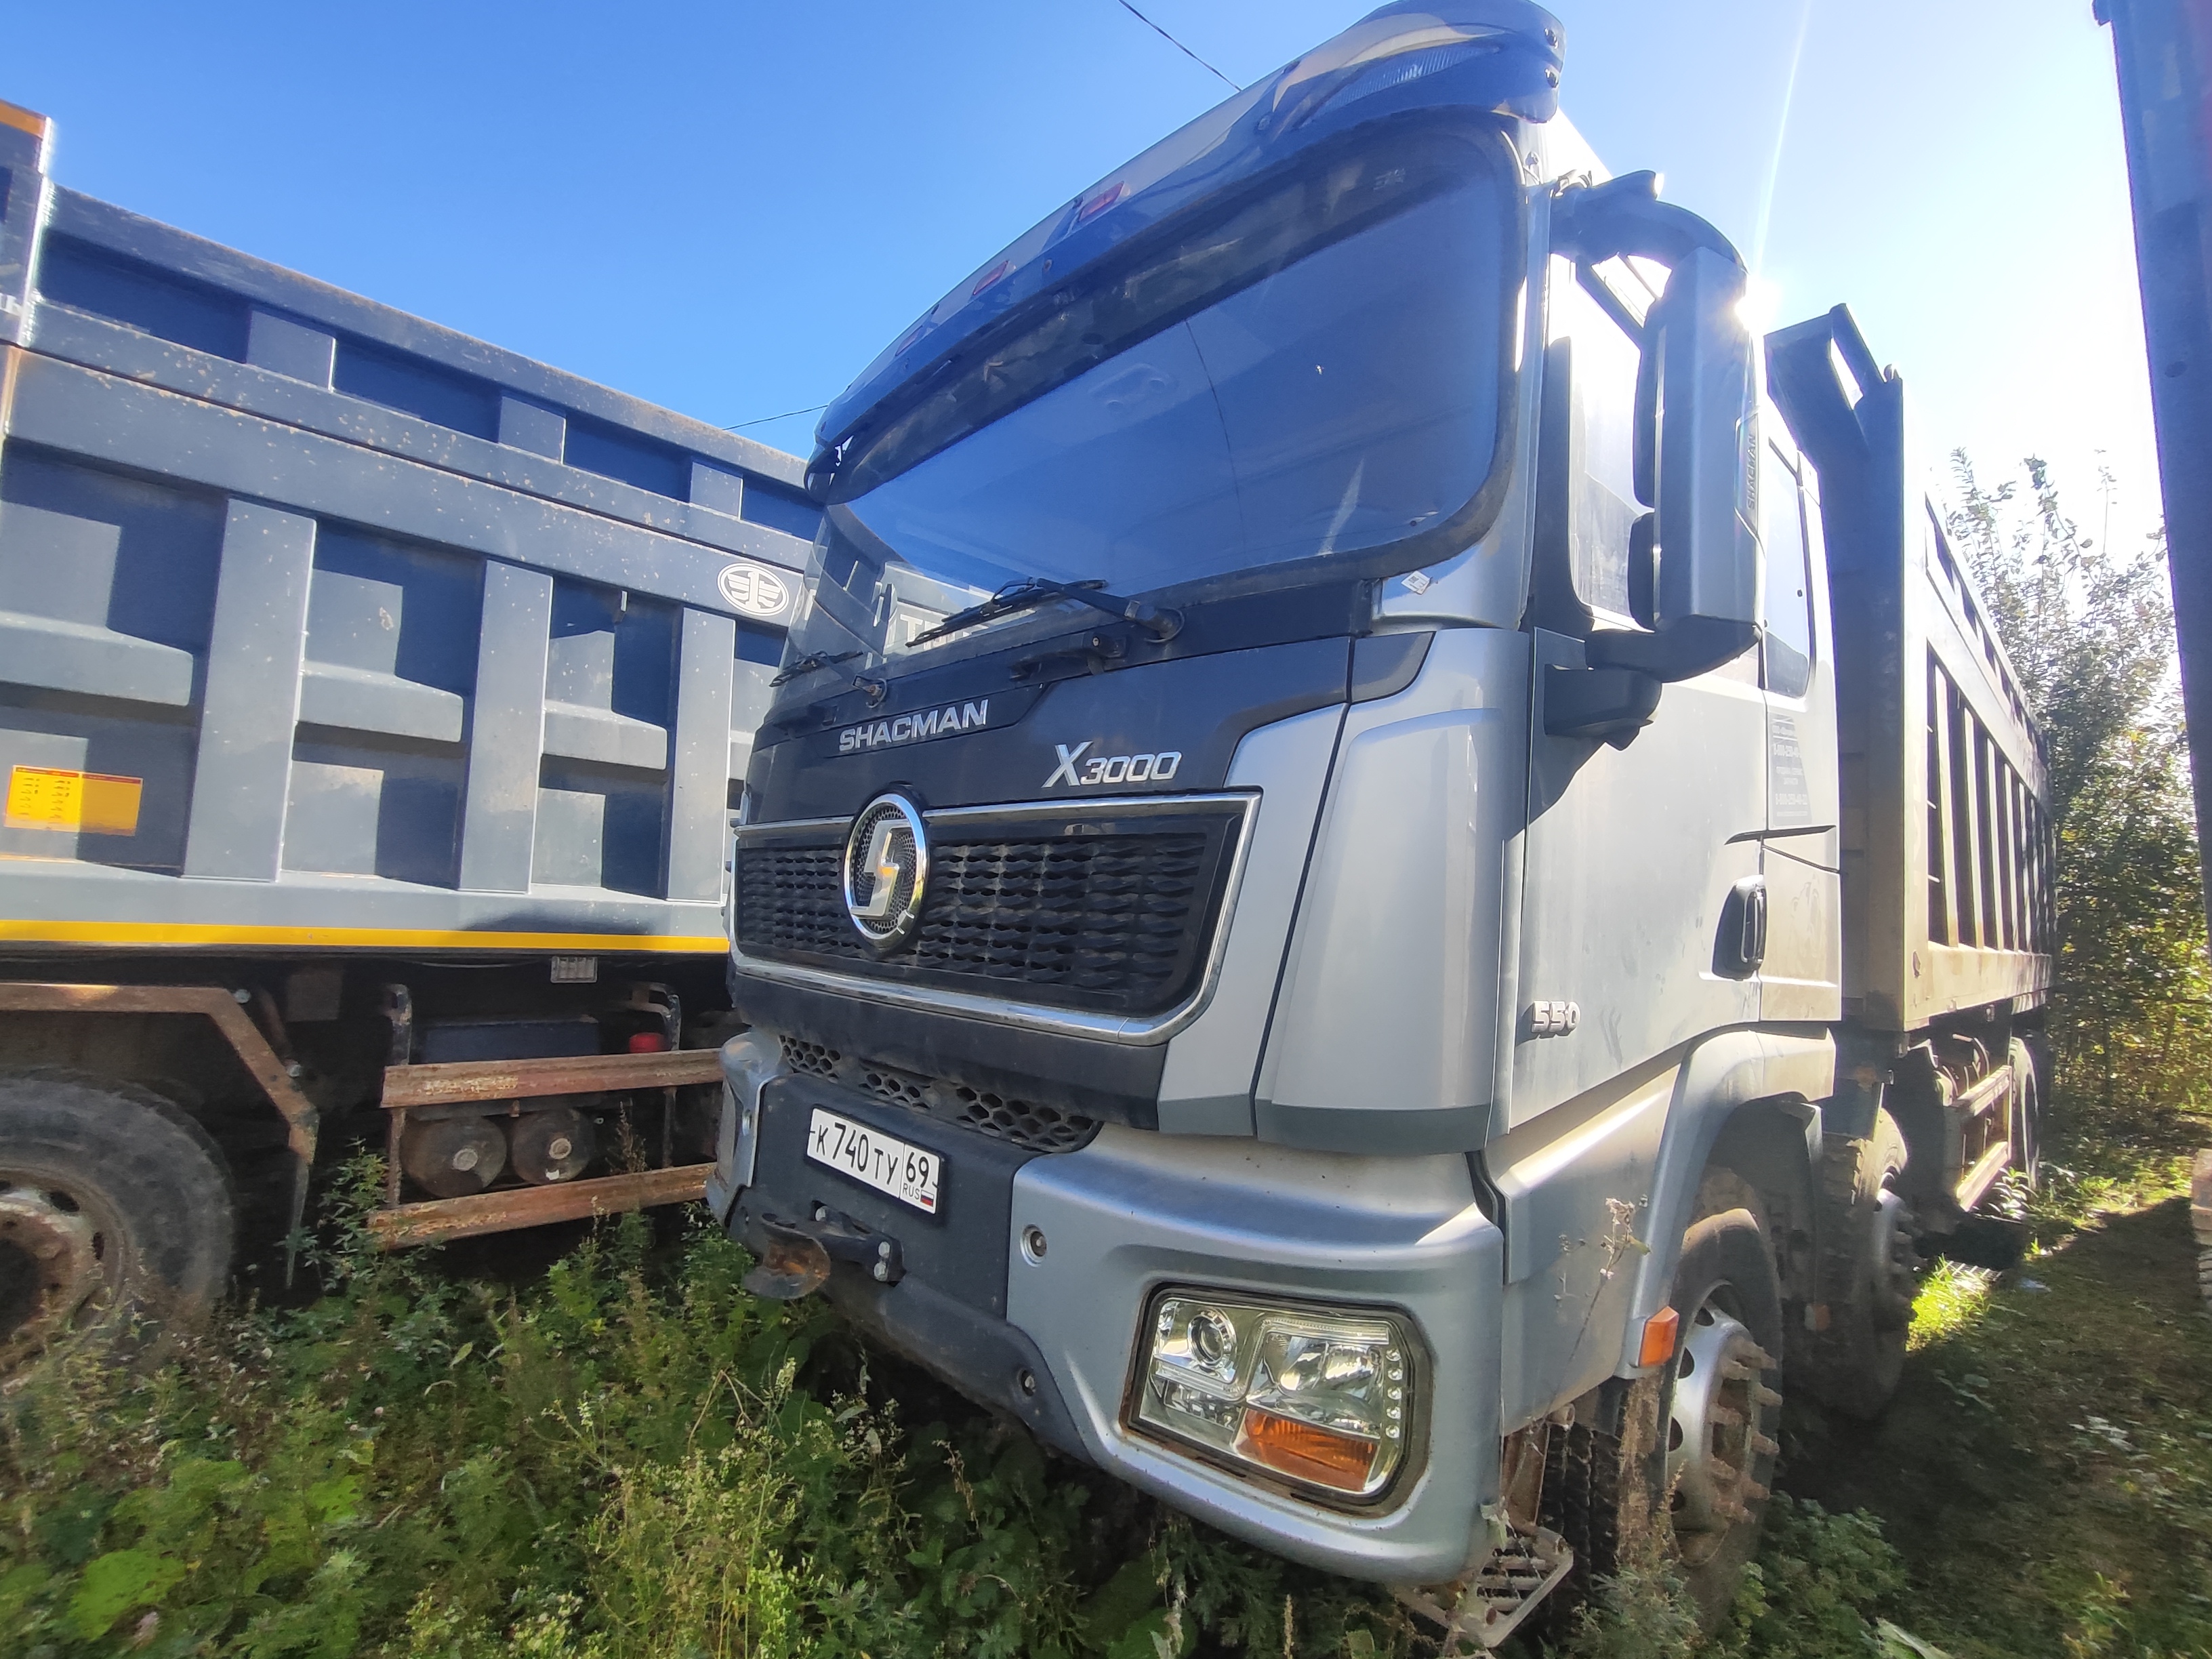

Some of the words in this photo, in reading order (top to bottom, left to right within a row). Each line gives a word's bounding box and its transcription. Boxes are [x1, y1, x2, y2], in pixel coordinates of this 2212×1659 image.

[1746, 434, 1756, 510] SHACMAN
[839, 699, 989, 752] SHACMAN
[1041, 741, 1183, 788] X3000
[1532, 1000, 1580, 1032] 550
[905, 1152, 929, 1188] 69
[902, 1183, 920, 1200] RUS
